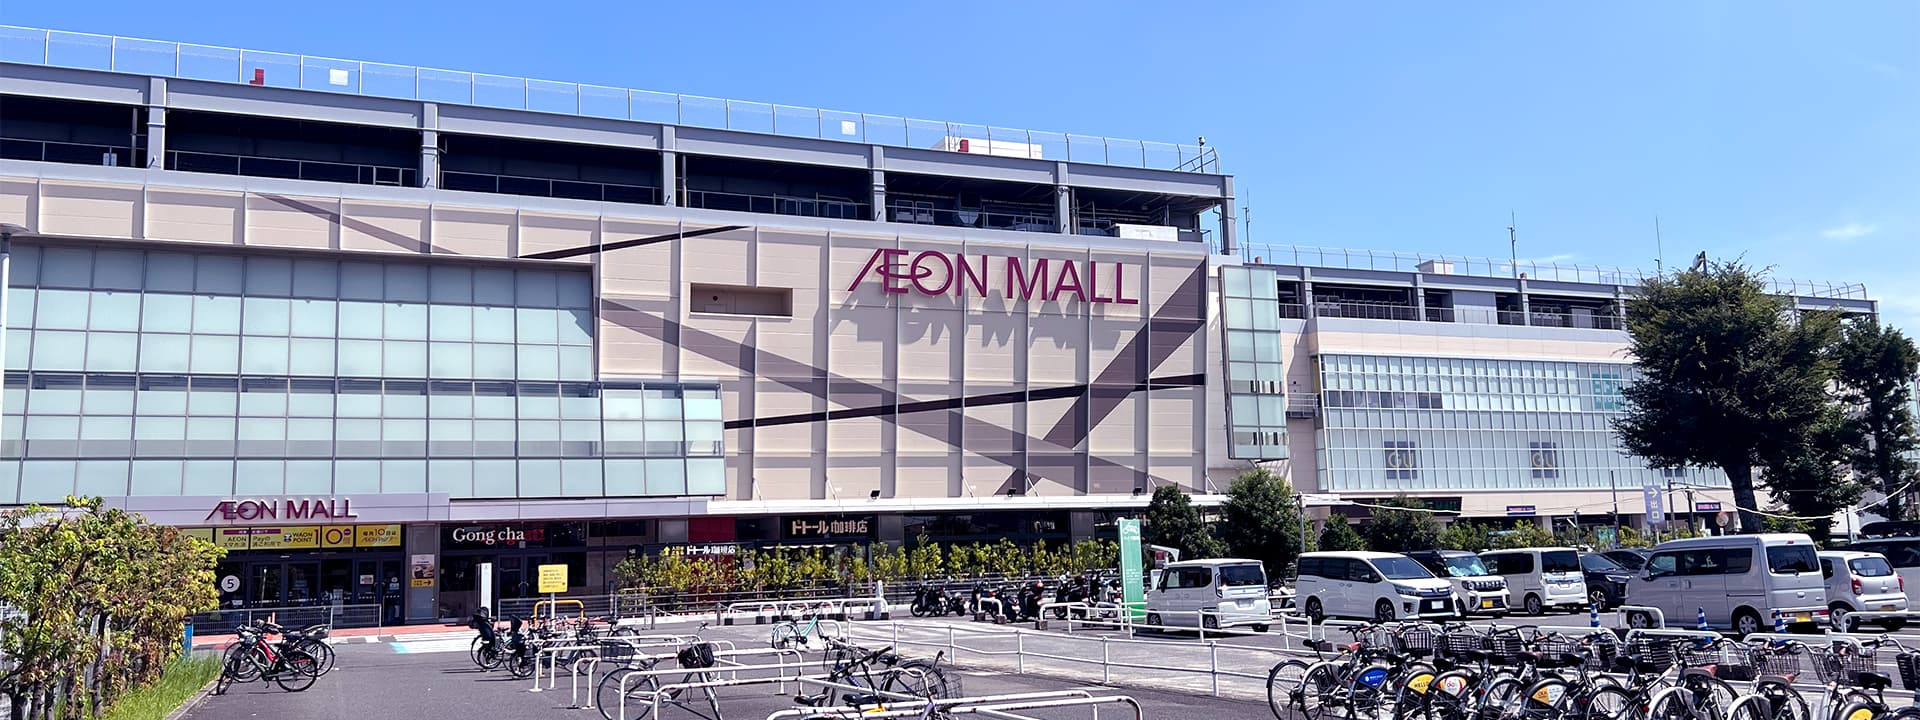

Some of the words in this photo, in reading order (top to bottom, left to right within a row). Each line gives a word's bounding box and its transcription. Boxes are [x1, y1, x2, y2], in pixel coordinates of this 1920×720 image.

[1008, 257, 1138, 304] MALL
[286, 499, 358, 519] MALL
[452, 528, 496, 545] Gong
[498, 527, 525, 541] cha
[228, 579, 234, 588] 5
